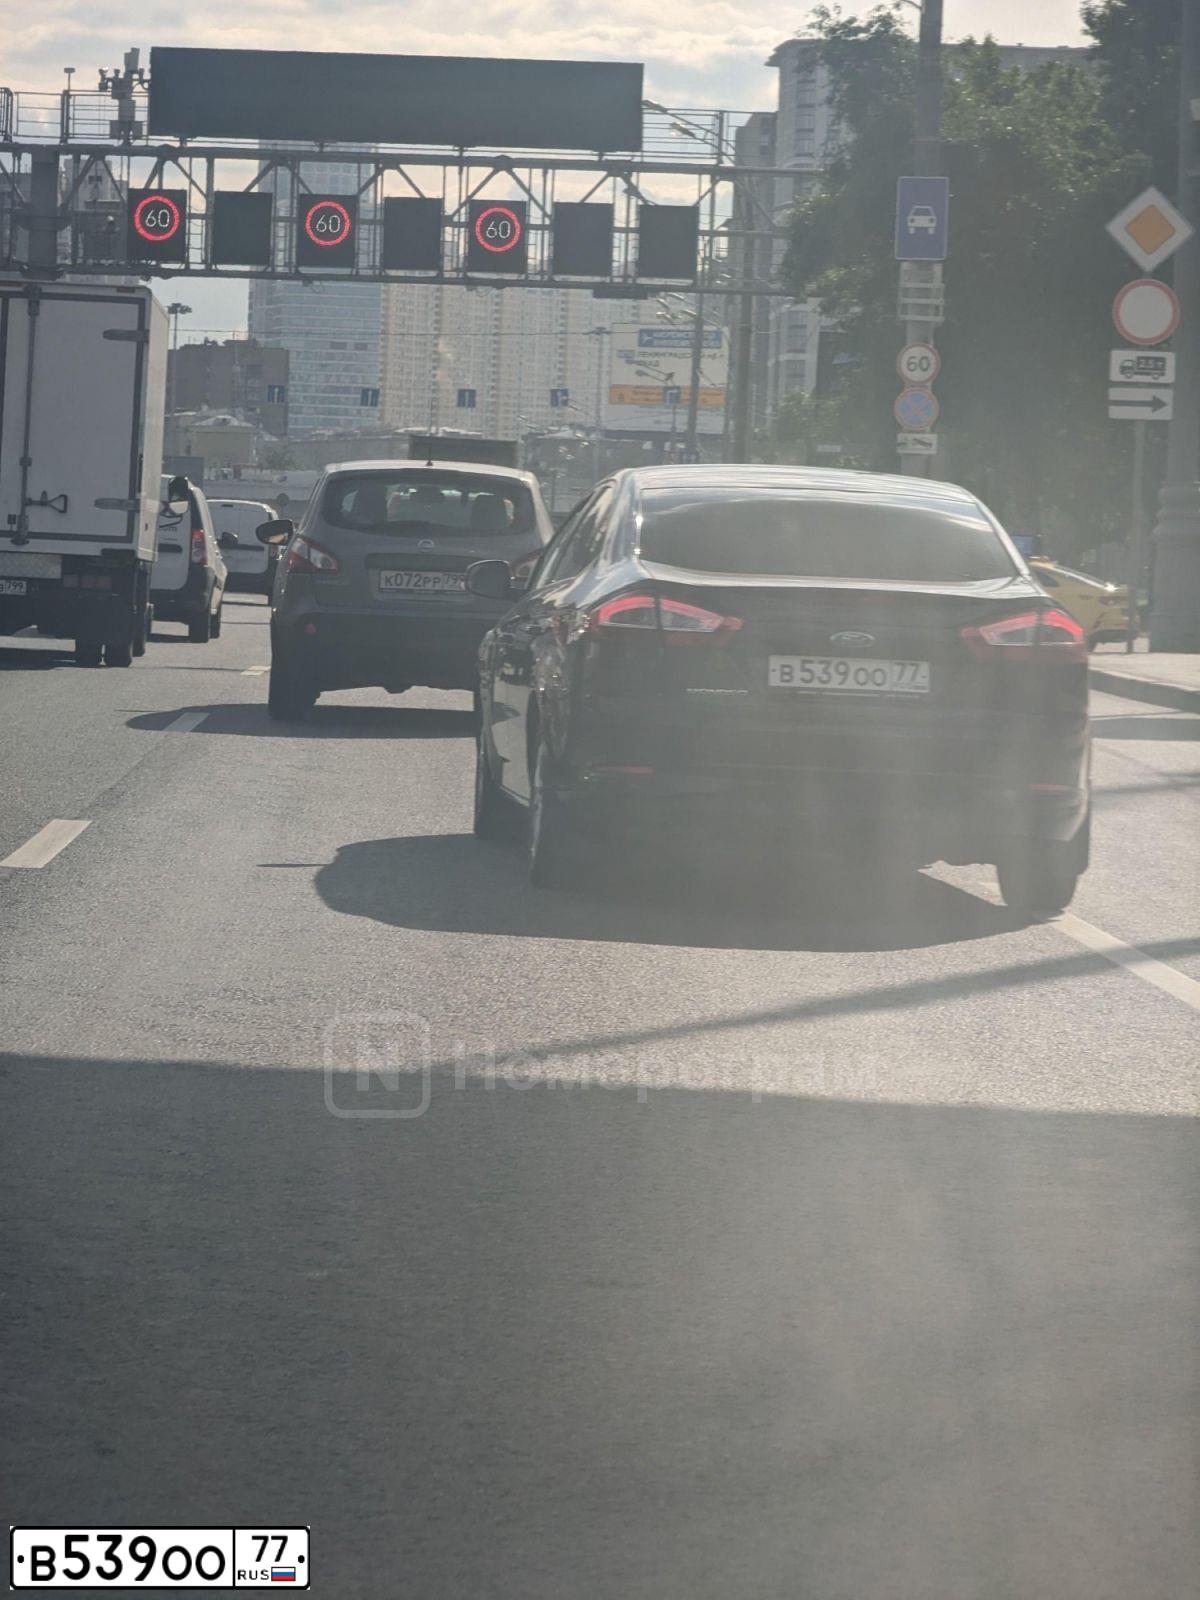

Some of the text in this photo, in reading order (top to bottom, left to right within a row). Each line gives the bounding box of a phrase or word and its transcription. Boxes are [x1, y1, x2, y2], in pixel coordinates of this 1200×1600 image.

[145, 209, 170, 228] 60
[316, 214, 341, 233] 60
[486, 220, 511, 239] 60
[907, 355, 930, 372] 60
[894, 663, 920, 682] 77
